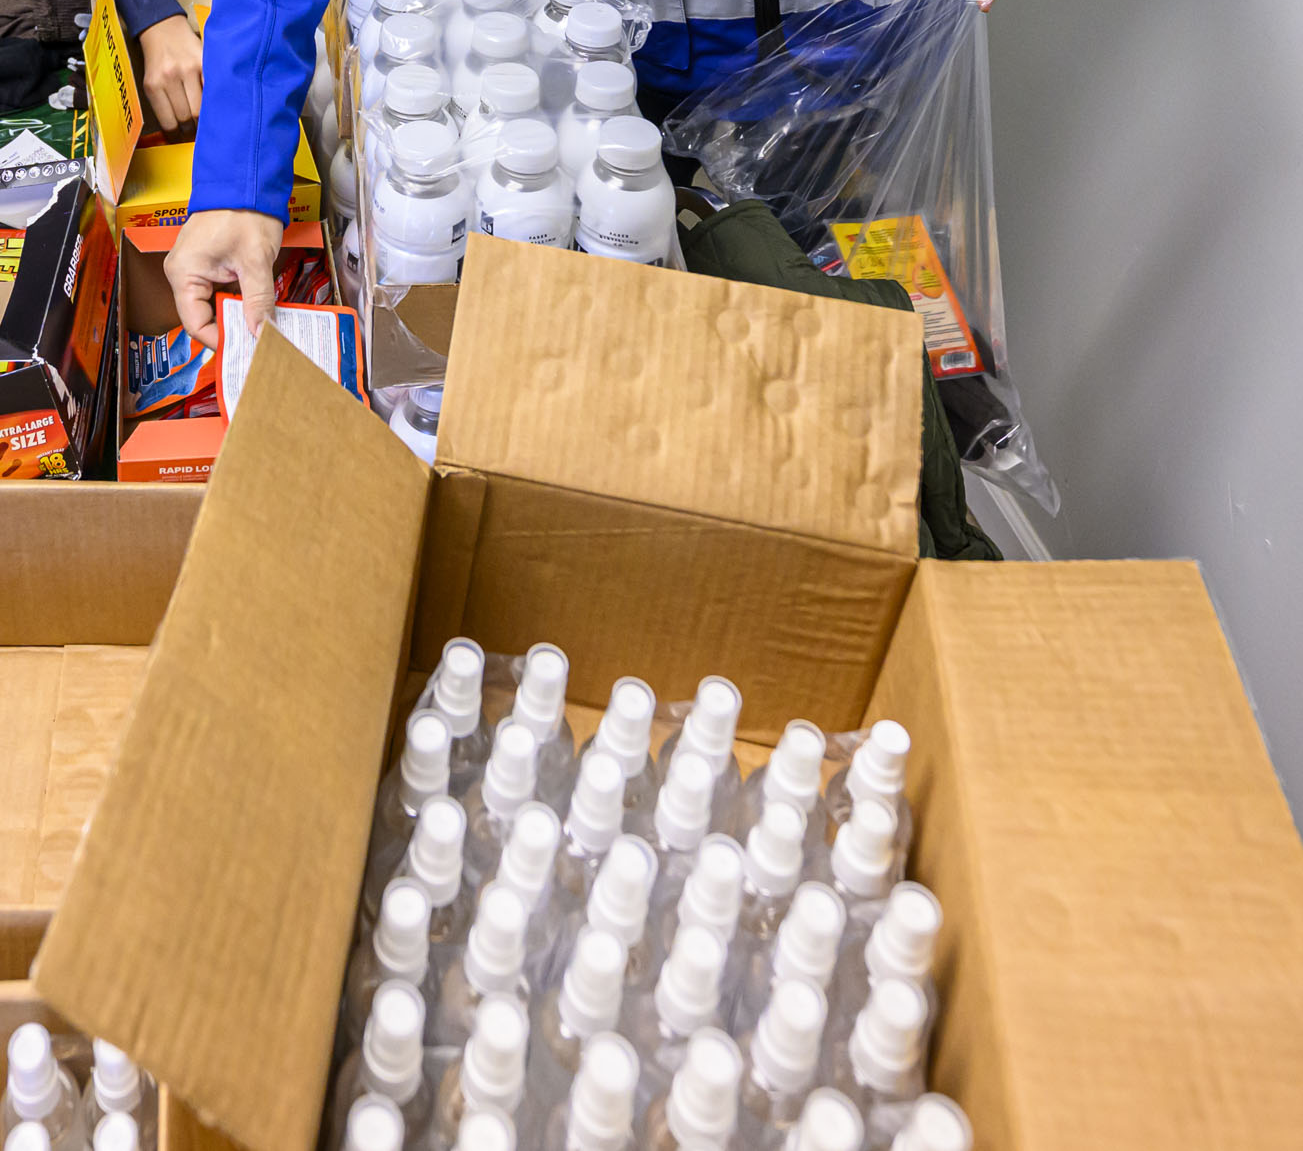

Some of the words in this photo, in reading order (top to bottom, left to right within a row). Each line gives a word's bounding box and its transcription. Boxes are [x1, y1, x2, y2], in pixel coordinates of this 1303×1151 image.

[106, 28, 117, 58] NOT
[112, 54, 134, 134] SEPARATE
[153, 207, 188, 218] SPOR
[288, 204, 310, 213] rmer
[63, 233, 85, 299] GRABBER
[9, 430, 47, 451] SIZE
[39, 452, 67, 470] 18
[159, 466, 193, 475] RAPID
